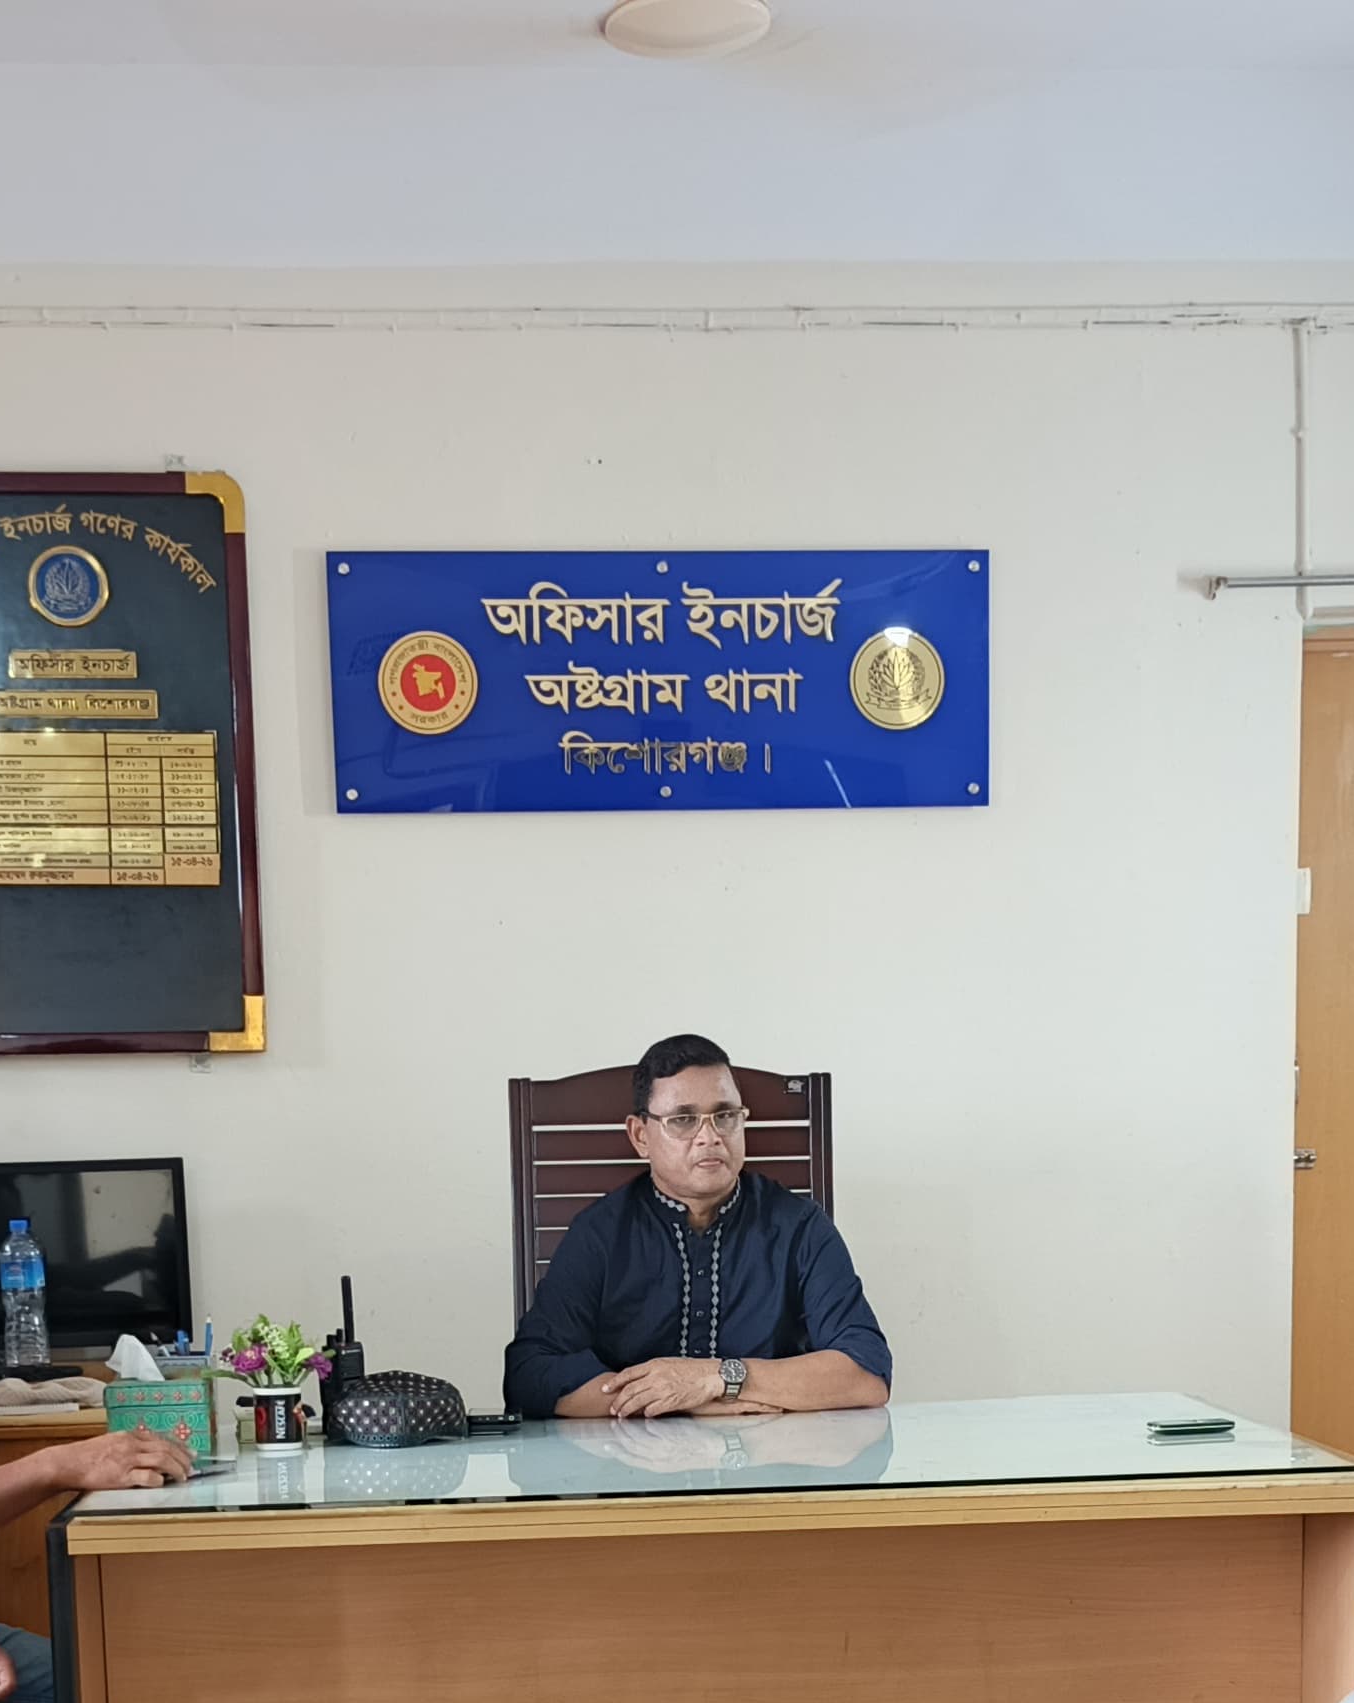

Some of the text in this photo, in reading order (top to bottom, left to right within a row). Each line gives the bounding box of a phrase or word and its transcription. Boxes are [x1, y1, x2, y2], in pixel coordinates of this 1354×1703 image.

[80, 510, 138, 541] গণের
[144, 526, 217, 593] কার্যকাল
[481, 578, 843, 650] অফিসার ইনচার্জ
[15, 654, 132, 672] অফিসার ইনচার্জ
[524, 660, 804, 715] অষ্টগ্রাম থানা
